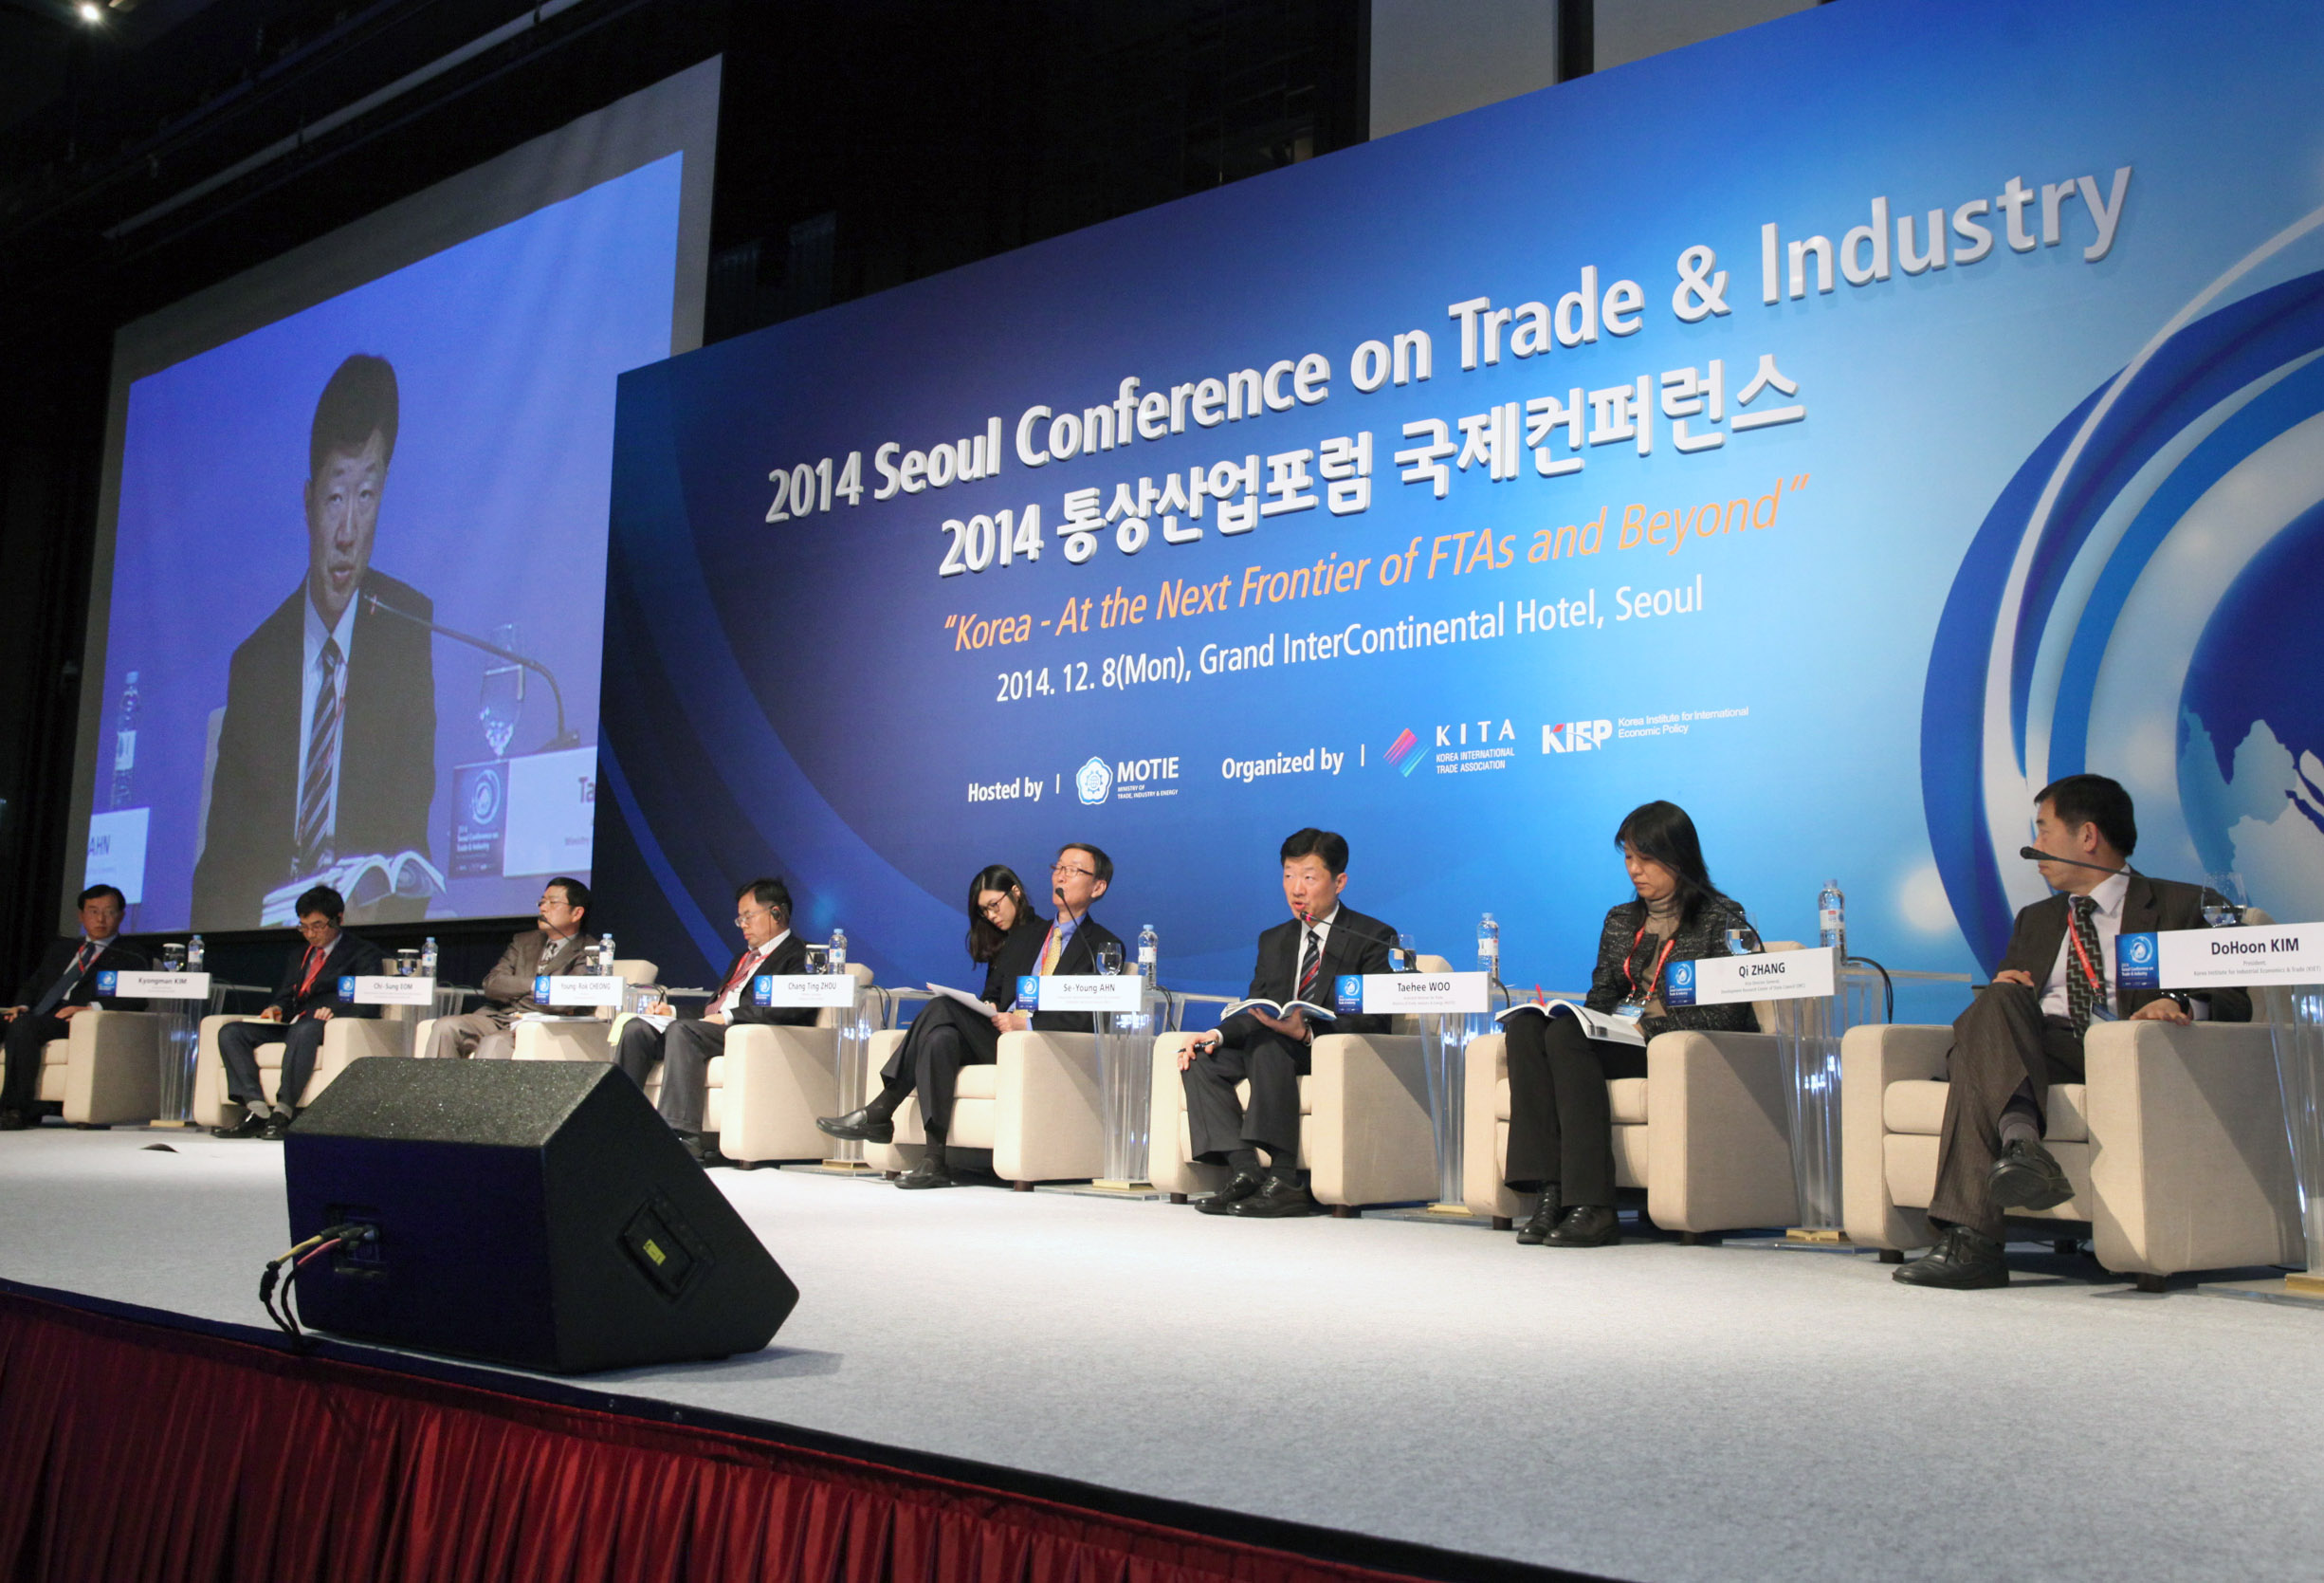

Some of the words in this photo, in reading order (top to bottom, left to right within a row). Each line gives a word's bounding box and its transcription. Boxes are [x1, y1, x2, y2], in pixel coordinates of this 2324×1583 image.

[765, 451, 864, 524] 2014
[873, 416, 1001, 500] Seoul
[1016, 353, 1328, 468] Conference
[1350, 328, 1432, 393] on
[1449, 265, 1646, 373] Trade
[1672, 244, 1732, 323] &
[1761, 165, 2133, 304] Industry
[939, 504, 1044, 578] 2014
[1056, 430, 1373, 565] 통상산업포럼
[1394, 353, 1807, 499] 국제컨퍼런스
[1054, 596, 1094, 636] At
[1100, 585, 1147, 628] the
[1156, 577, 1231, 621] Next
[1238, 555, 1371, 608] Frontier
[1378, 537, 1422, 586] of
[1427, 527, 1515, 582] FTAs
[1527, 506, 1605, 563] and
[997, 670, 1055, 703] 2014.
[1063, 661, 1095, 694] 12.
[1102, 646, 1191, 691] 8(Mon),
[1199, 633, 1273, 676] Grand
[1284, 598, 1504, 662] InterContinental
[1517, 583, 1604, 636] Hotel,
[1615, 574, 1704, 621] Seoul
[1618, 717, 1644, 727] Korea
[1646, 713, 1680, 725] Institute
[1681, 711, 1693, 722] for
[1693, 706, 1749, 721] International
[1542, 718, 1612, 755] KIEP
[1618, 725, 1661, 739] Economic
[1662, 724, 1690, 735] Policy
[1436, 752, 1459, 763] KOREA
[1460, 747, 1515, 761] INTERNATIONAL
[1117, 757, 1180, 783] MOTIE
[1221, 748, 1315, 783] Organized
[1321, 747, 1344, 776] by
[1436, 764, 1458, 774] TRADE
[1460, 760, 1506, 773] ASSOCIATION
[968, 778, 1019, 802] Hosted
[1024, 777, 1043, 801] by
[1133, 790, 1156, 799] INDUSTRY
[2211, 940, 2266, 956] DoHoon
[2270, 937, 2299, 952] KIM
[1738, 966, 1749, 978] Qi
[1750, 962, 1785, 976] ZHANG
[137, 977, 173, 986] Kyongman
[788, 982, 806, 992] Chang
[820, 982, 837, 990] ZHOU
[1063, 983, 1098, 994] Se-Young
[1099, 983, 1116, 992] AHN
[1397, 982, 1426, 993] Taehee
[1428, 982, 1451, 992] WOO
